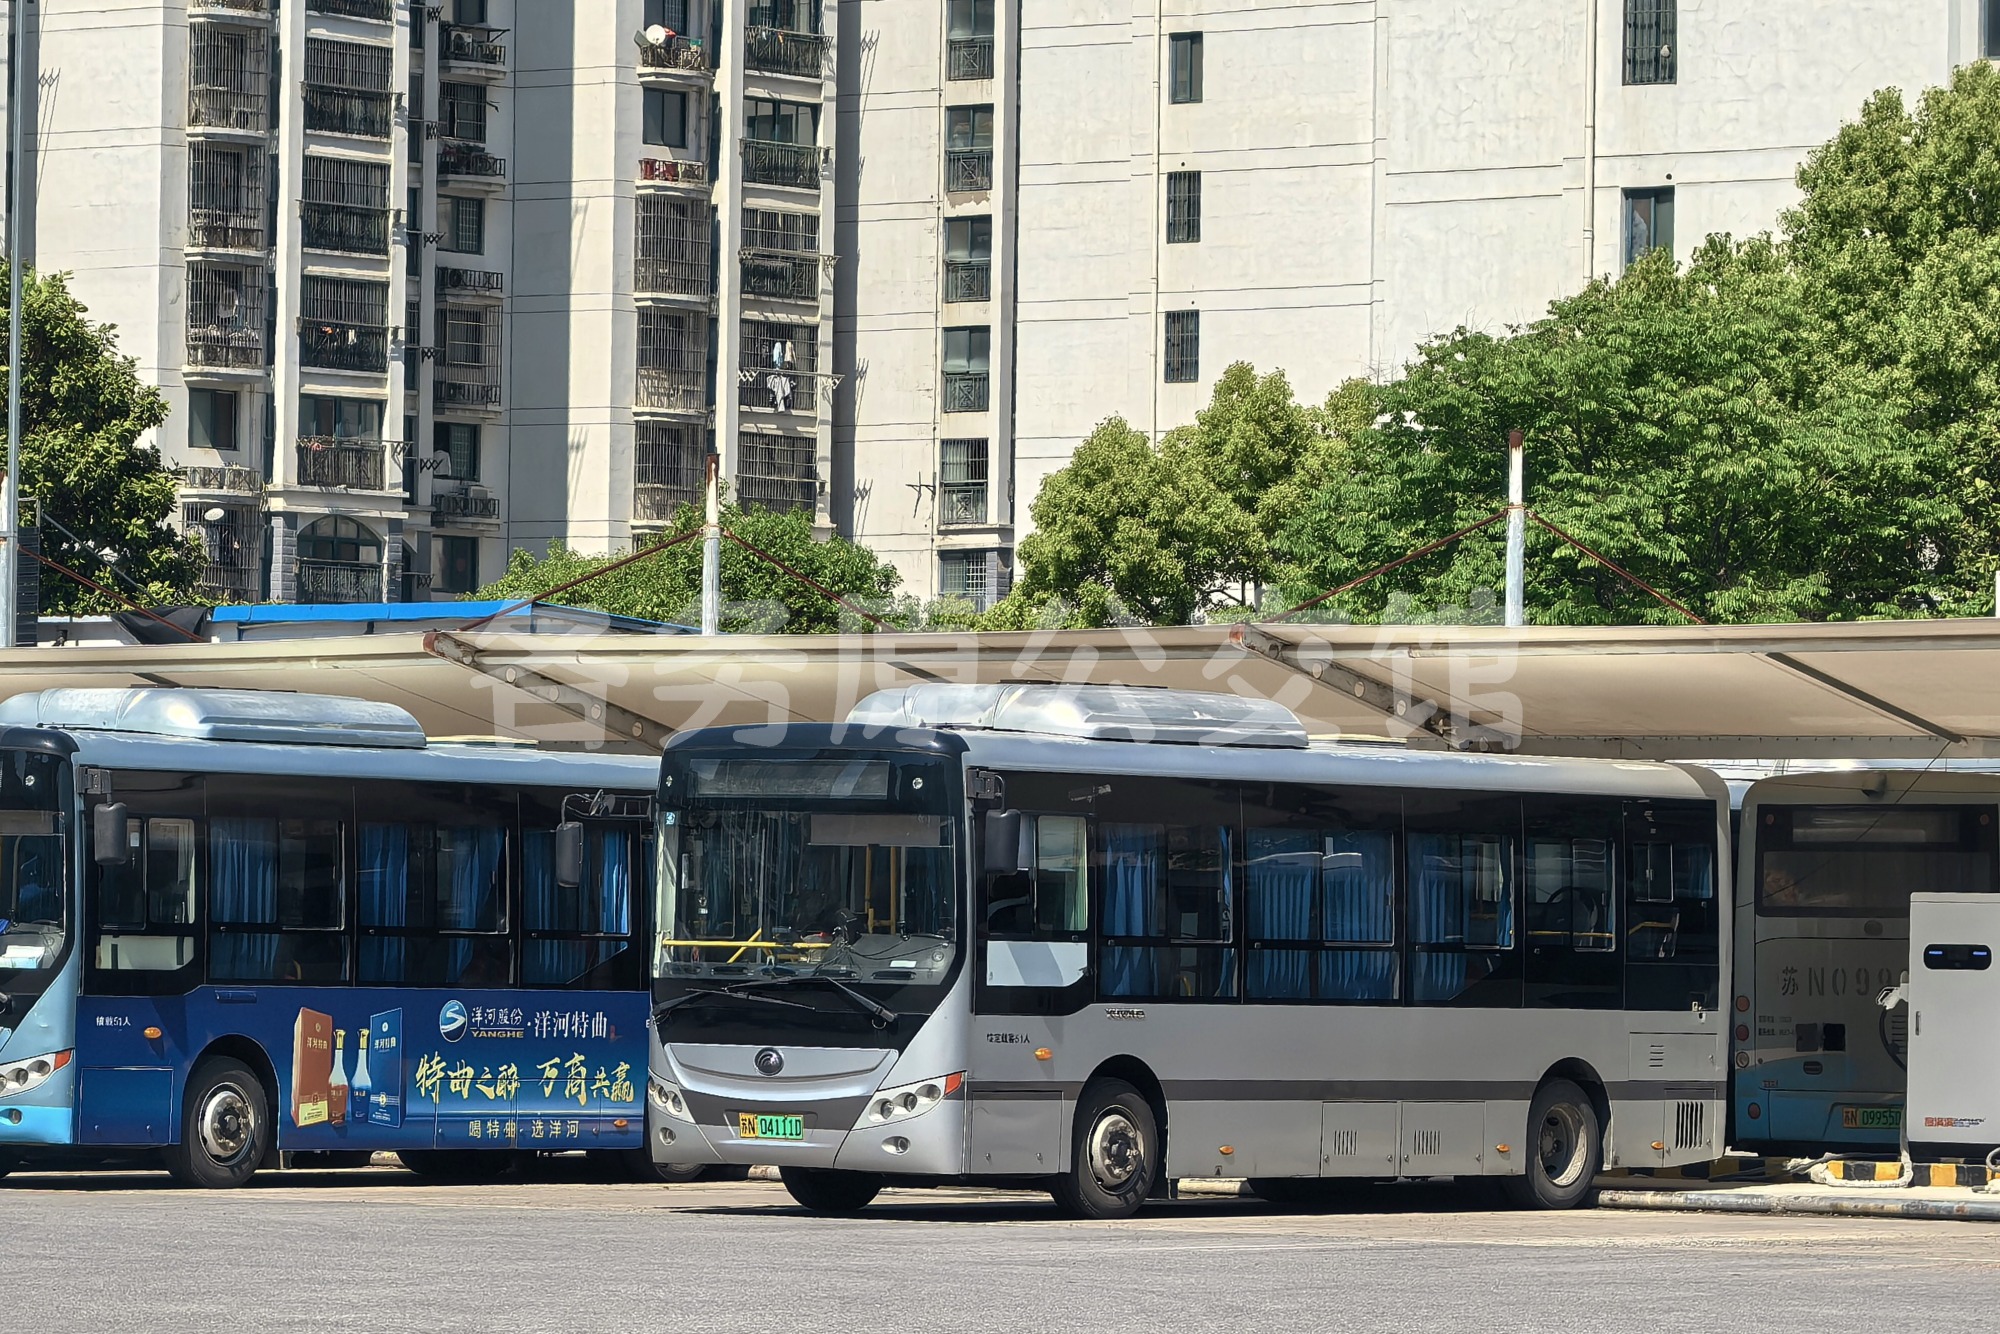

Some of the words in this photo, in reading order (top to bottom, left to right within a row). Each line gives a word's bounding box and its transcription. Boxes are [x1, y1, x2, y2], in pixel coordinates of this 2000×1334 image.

[471, 1006, 524, 1026] 洋河股份
[471, 1030, 524, 1039] YANGHE
